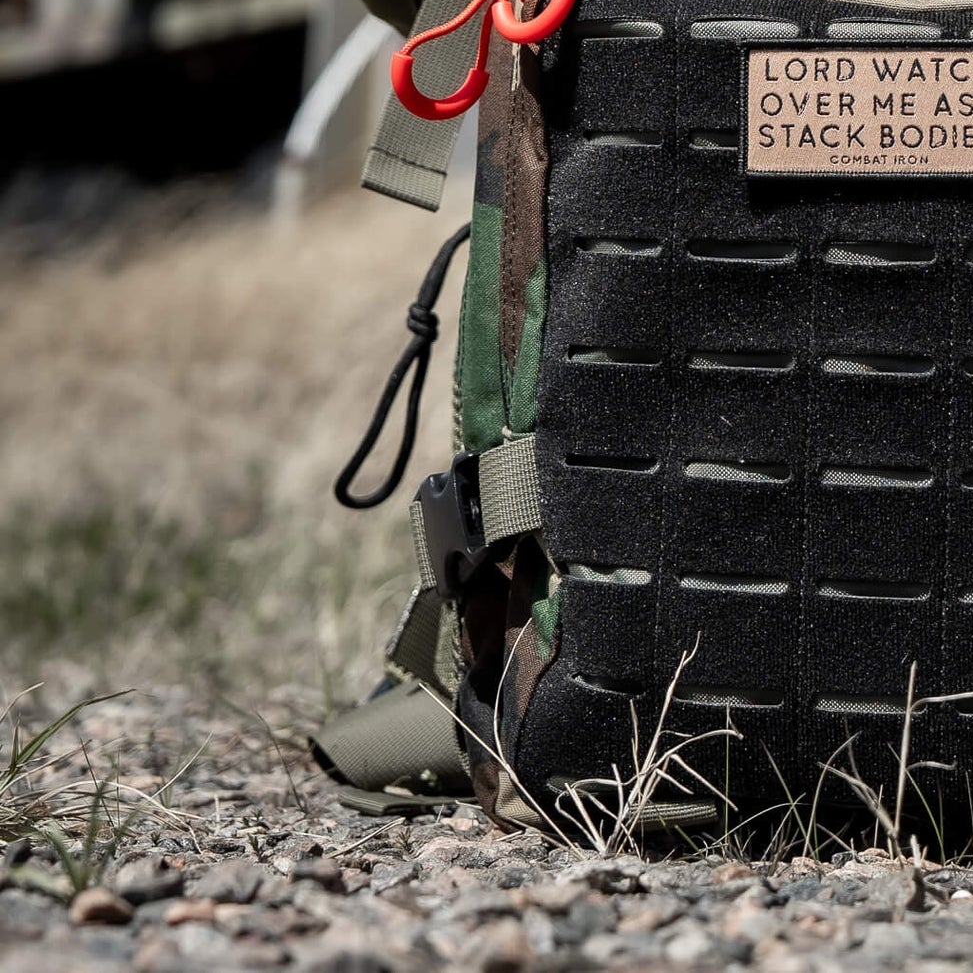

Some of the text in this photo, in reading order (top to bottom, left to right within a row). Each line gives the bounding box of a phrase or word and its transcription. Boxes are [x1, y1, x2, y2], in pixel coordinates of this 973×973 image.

[764, 57, 856, 82] LORD
[760, 92, 856, 116] OVER
[872, 92, 917, 116] ME
[758, 123, 866, 148] STACK
[829, 154, 930, 165] COMBAT IRON
